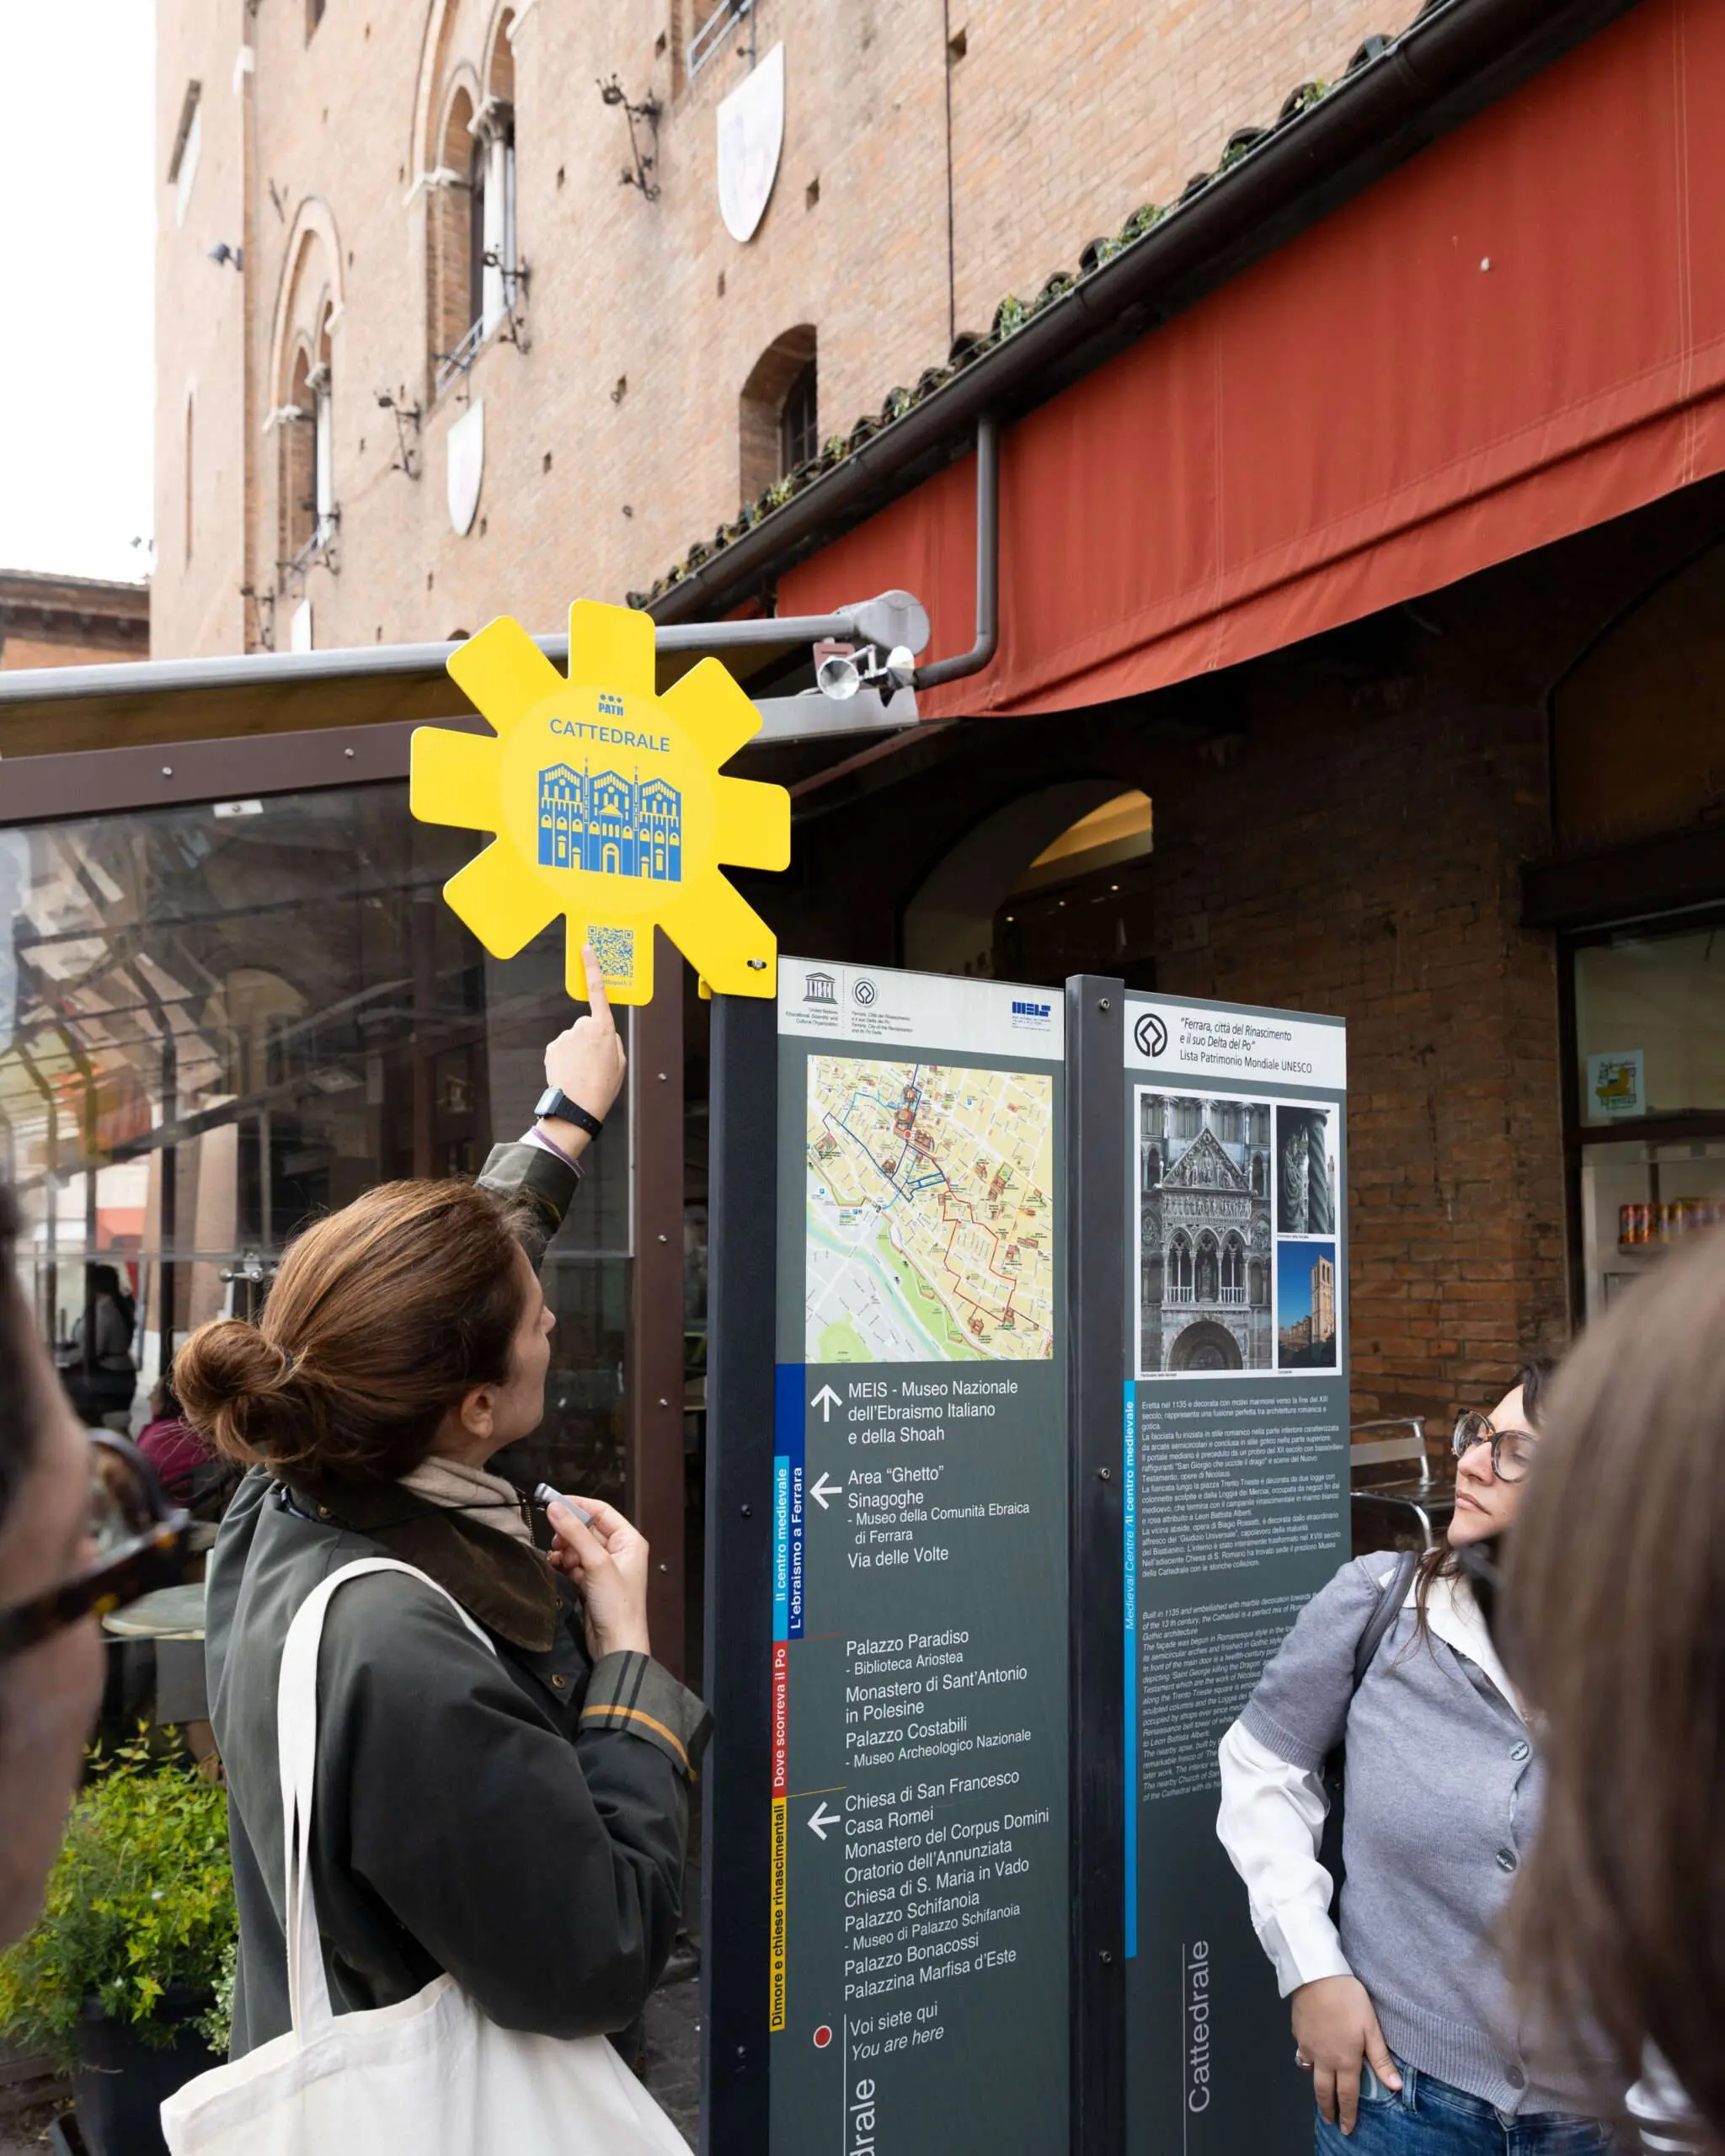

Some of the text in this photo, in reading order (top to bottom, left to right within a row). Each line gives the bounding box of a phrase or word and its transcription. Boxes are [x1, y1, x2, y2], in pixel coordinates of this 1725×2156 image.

[598, 703, 624, 716] PATH
[550, 718, 670, 752] CATTEDRALE
[1187, 1034, 1191, 1043] il
[1193, 1038, 1205, 1046] suo
[1208, 1036, 1227, 1048] Delta
[1229, 1038, 1241, 1049] del
[1215, 1023, 1230, 1033] città
[1232, 1024, 1243, 1035] del
[1246, 1026, 1291, 1041] Rinascimento
[1180, 1050, 1311, 1073] Lista Patrimonio Mondiale UNESCO
[848, 1382, 887, 1398] MEIS
[902, 1381, 948, 1396] Museo
[953, 1380, 1017, 1396] Nazionale
[848, 1403, 995, 1422] dell'Ebraismo Italiano
[848, 1427, 944, 1444] e della Shoah
[1125, 1401, 1134, 1465] medievale
[792, 1468, 802, 1523] Ferrara
[848, 1470, 882, 1485] Area
[1125, 1470, 1134, 1511] centro
[777, 1469, 787, 1540] medievale
[848, 1490, 923, 1510] Sinagoghe
[857, 1513, 895, 1525] Museo
[900, 1509, 927, 1522] della
[931, 1504, 985, 1520] Comunità
[989, 1502, 1029, 1515] Ebraica
[856, 1530, 913, 1545] di Ferrara
[1125, 1531, 1134, 1572] Centre
[777, 1544, 786, 1588] centro
[848, 1546, 948, 1568] Via delle Volte
[791, 1542, 801, 1628] L'ebraismo
[1125, 1576, 1134, 1630] Medieval
[776, 1649, 785, 1667] Po
[846, 1630, 969, 1657] Palazzo Paradiso
[855, 1658, 911, 1675] Biblioteca
[916, 1652, 964, 1668] Ariostea
[846, 1665, 1027, 1703] Monastero di Sant'Antonio
[776, 1684, 785, 1746] scorreva
[846, 1701, 924, 1723] in Polesine
[846, 1716, 967, 1748] Palazzo Costabili
[854, 1753, 894, 1768] Museo
[899, 1739, 973, 1760] Archeologico
[977, 1729, 1031, 1748] Nazionale
[774, 1750, 785, 1786] Dove
[846, 1772, 1019, 1812] Chiesa di San Francesco
[845, 1806, 933, 1836] Casa Romei
[846, 1807, 1049, 1860] Monastero del Corpus Domini
[773, 1806, 784, 1905] rinascimentali
[845, 1840, 1012, 1883] Oratorio dell'Annunziata
[845, 1859, 1028, 1908] Chiesa di S. Maria in Vado
[845, 1892, 980, 1932] Palazzo Schifanoia
[853, 1933, 893, 1951] Museo
[898, 1926, 908, 1940] di
[912, 1919, 958, 1937] Palazzo
[962, 1903, 1020, 1926] Schifanoia
[773, 1910, 782, 1956] chiese
[845, 1932, 979, 1976] Palazzo Bonacossi
[845, 1949, 1016, 2001] Palazzina Marfisa d'Este
[772, 1974, 782, 2025] Dimore
[851, 2001, 937, 2036] Voi siete qui
[852, 2026, 944, 2061] You are here
[1188, 1940, 1210, 2113] Cattedrale
